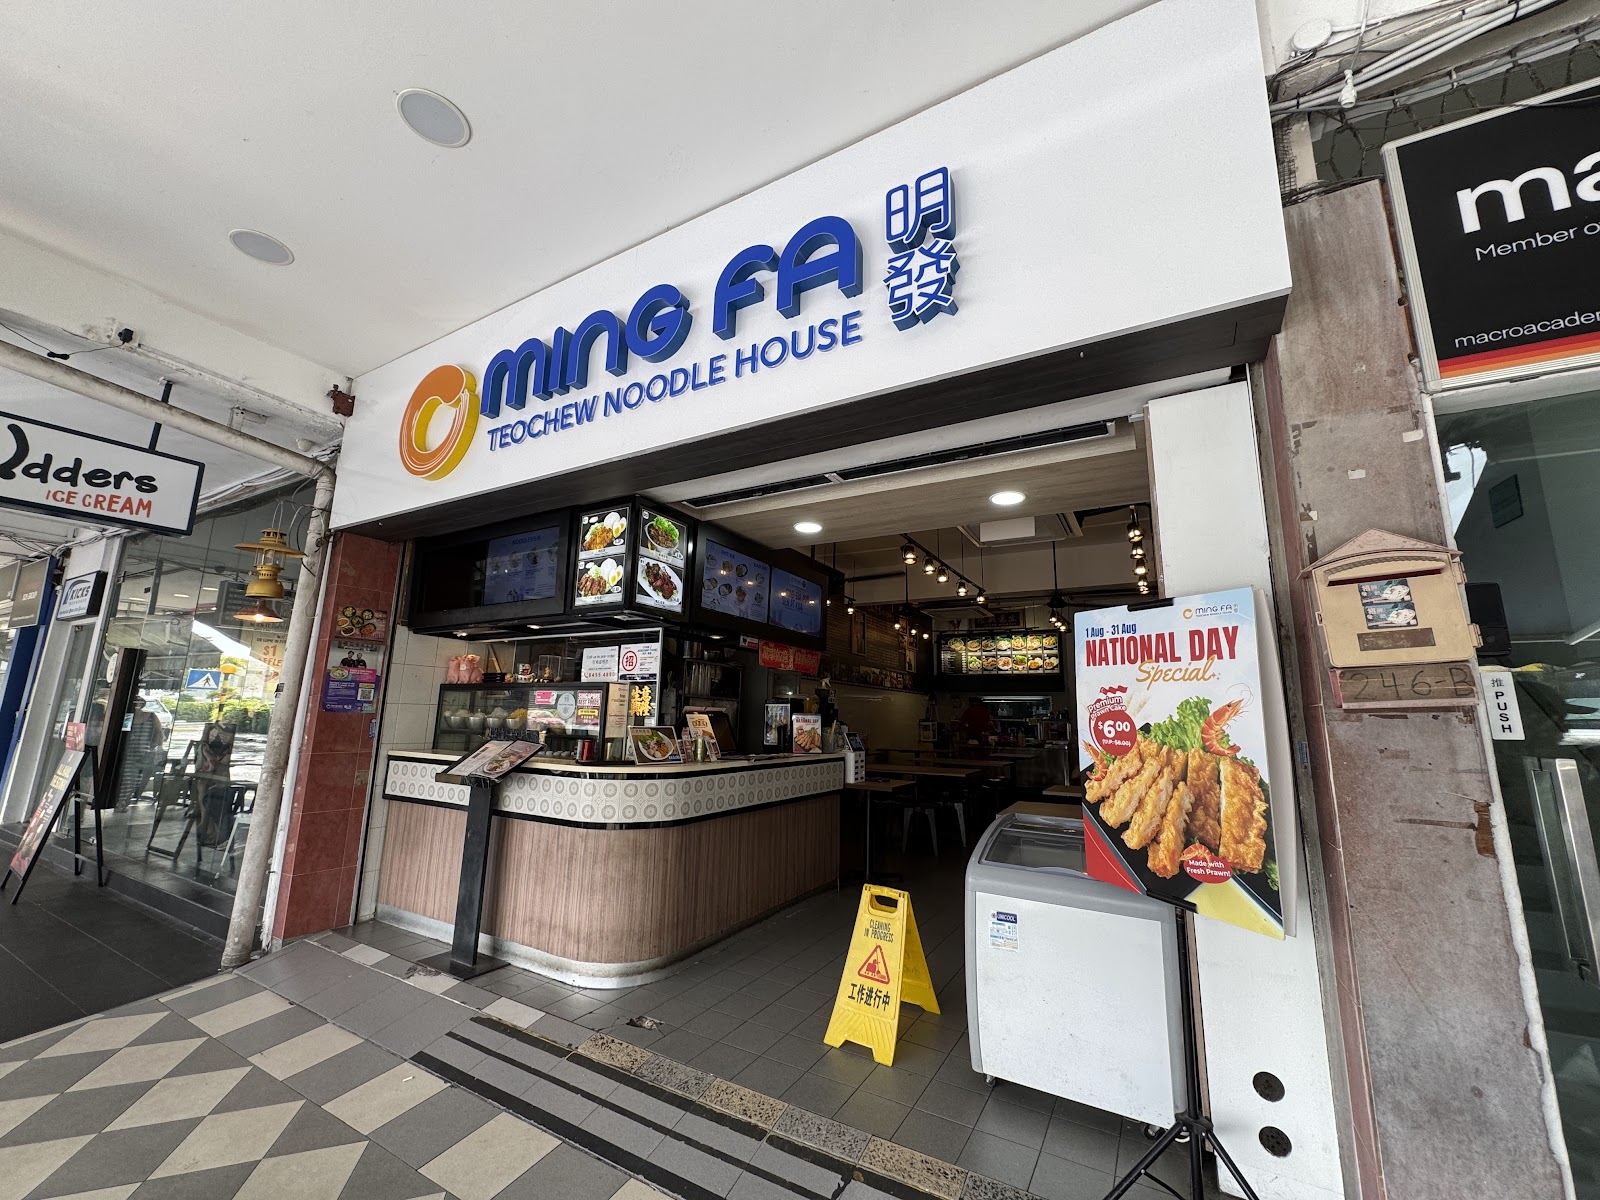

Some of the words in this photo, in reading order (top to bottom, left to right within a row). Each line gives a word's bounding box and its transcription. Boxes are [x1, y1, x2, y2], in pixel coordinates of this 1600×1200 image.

[883, 166, 960, 331] 明發
[1475, 225, 1578, 261] Member
[1583, 221, 1600, 235] o
[712, 215, 864, 340] FA
[1454, 310, 1600, 348] macroacade
[486, 394, 600, 452] TEOCHEW
[602, 352, 727, 415] NOODLE
[735, 309, 863, 379] HOUSE
[46, 490, 78, 505] ICE
[82, 494, 152, 518] CREAM
[1085, 628, 1090, 638] 1
[1090, 626, 1104, 639] Aug
[1111, 624, 1120, 635] 31
[1121, 623, 1137, 635] Aug
[1085, 632, 1181, 667] NATIONAL
[1188, 625, 1239, 662] DAY
[1135, 655, 1216, 690] Special
[1491, 678, 1504, 688] 推
[1087, 695, 1124, 714] Premium
[1495, 691, 1512, 733] PUSH
[1186, 866, 1205, 875] Fresh
[1206, 868, 1231, 877] Prawn!
[1188, 859, 1206, 867] Made
[1208, 860, 1225, 868] with
[864, 927, 869, 937] IN
[870, 928, 894, 943] PROGRESS
[869, 918, 891, 933] CLEANING
[848, 982, 891, 1011] 工作进行中
